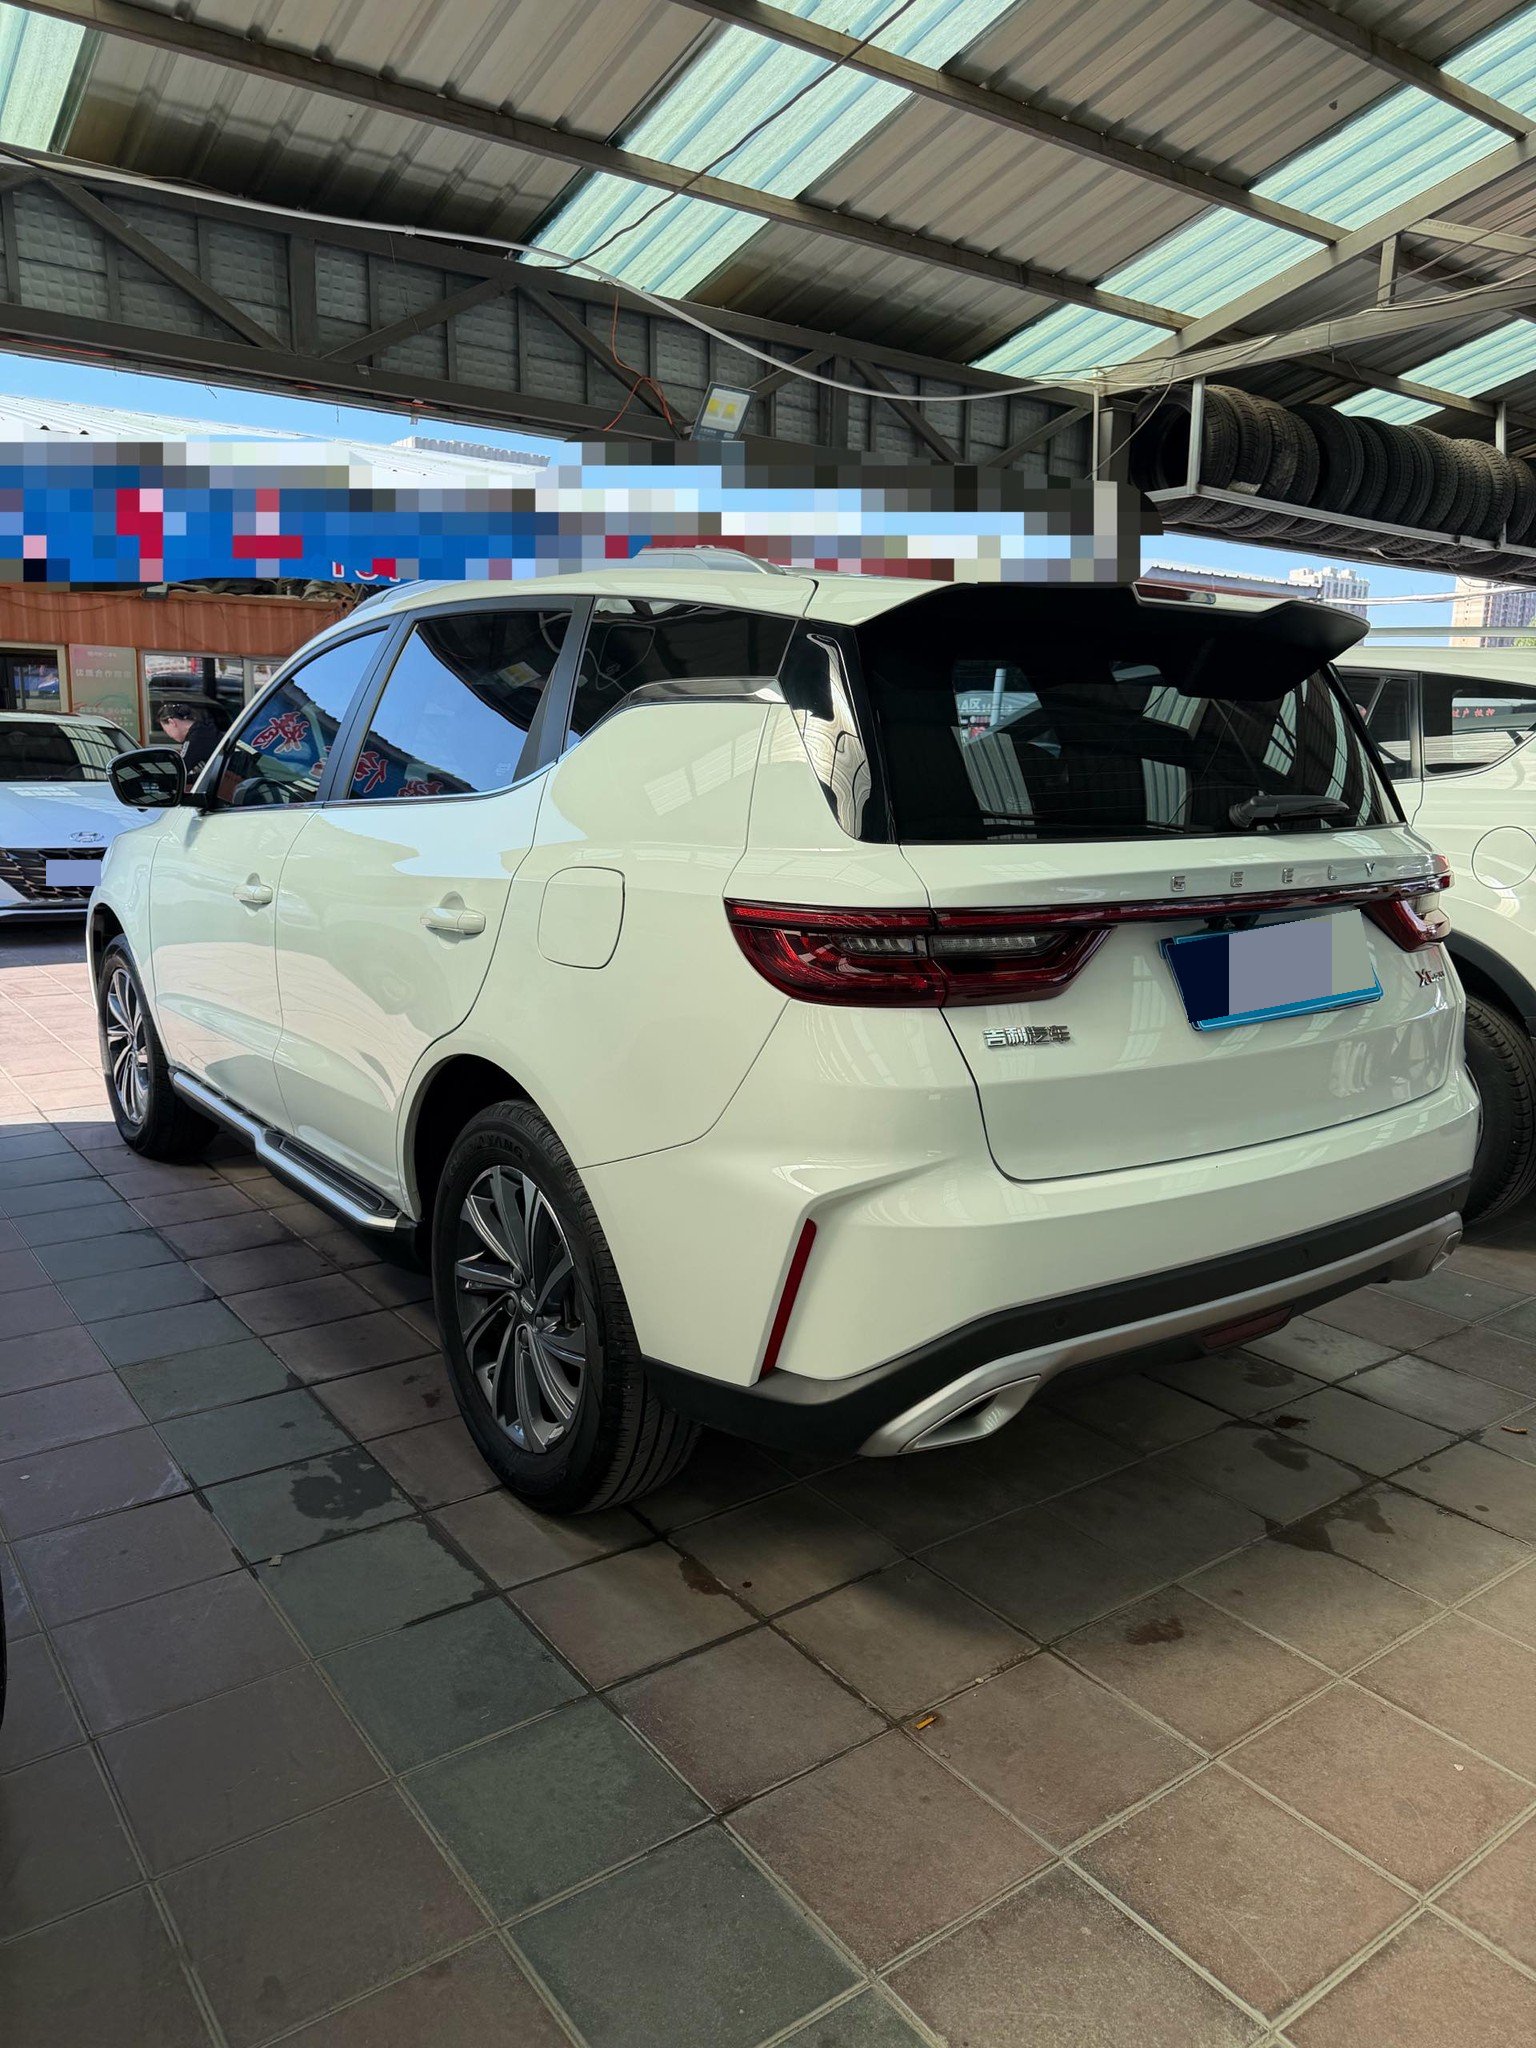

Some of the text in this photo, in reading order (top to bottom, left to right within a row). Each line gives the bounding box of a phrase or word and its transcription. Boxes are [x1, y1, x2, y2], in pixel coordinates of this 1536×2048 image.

[1171, 861, 1376, 892] GEELY
[983, 1025, 1071, 1047] 吉利汽车
